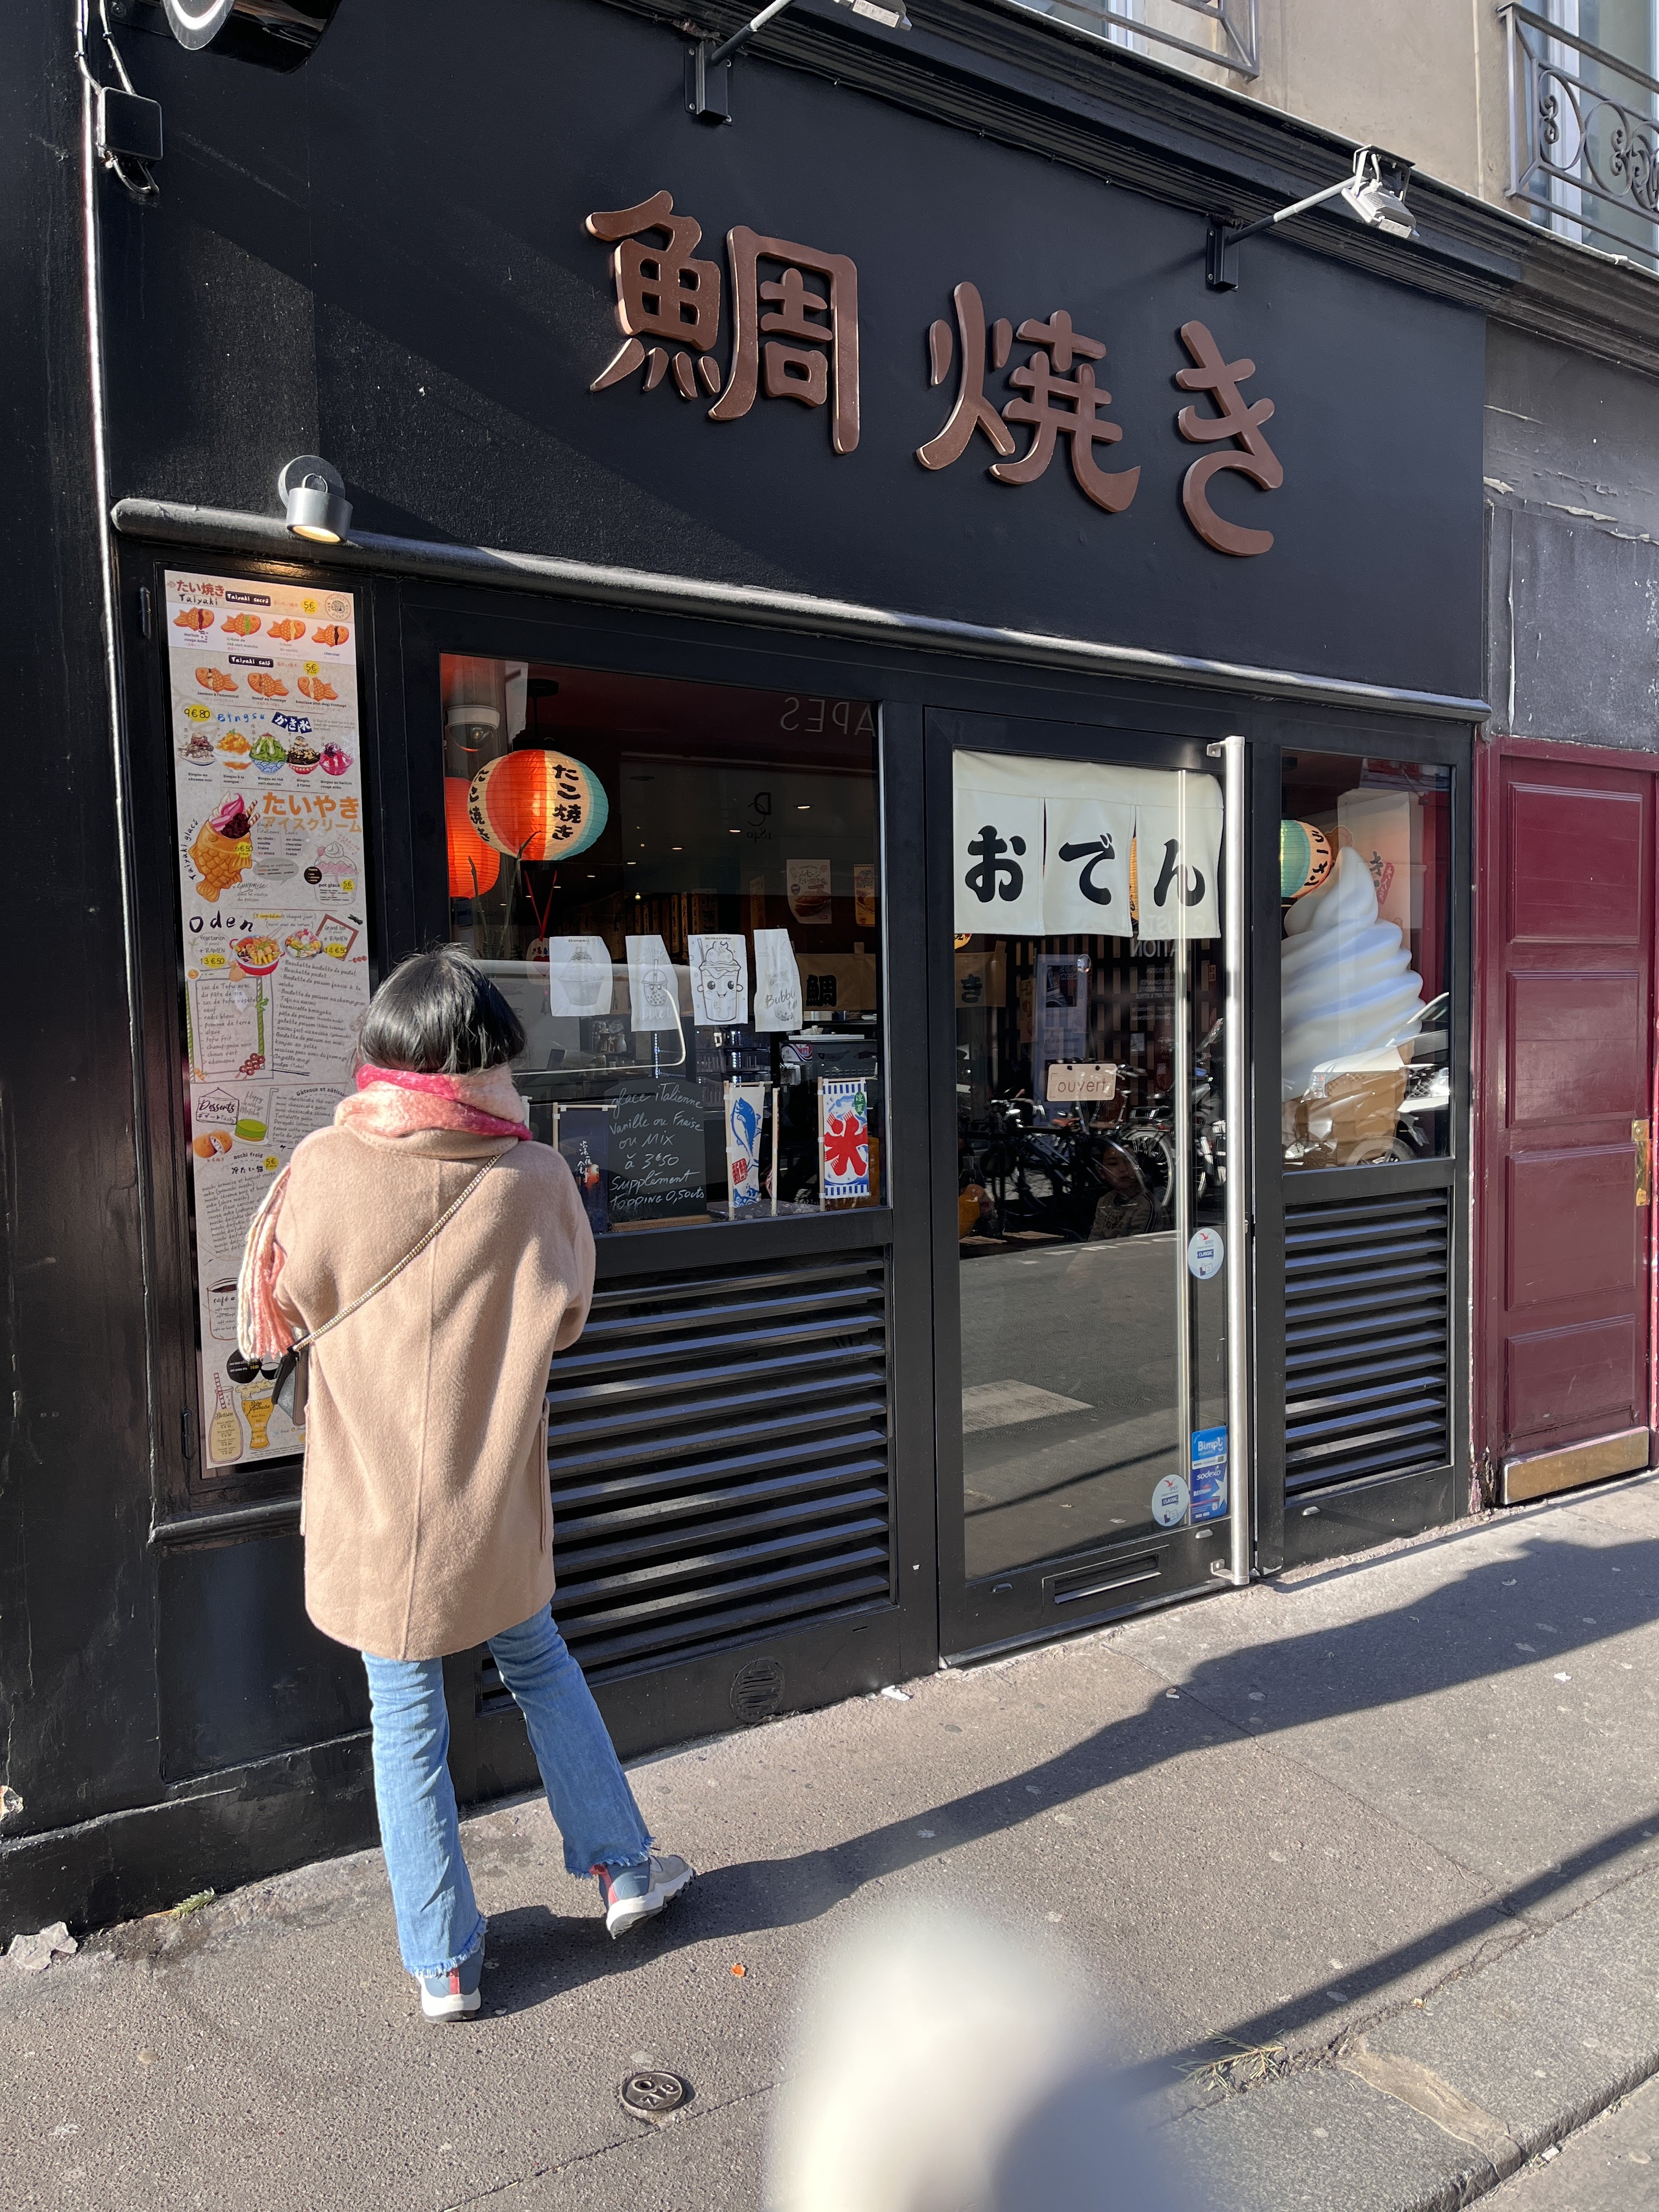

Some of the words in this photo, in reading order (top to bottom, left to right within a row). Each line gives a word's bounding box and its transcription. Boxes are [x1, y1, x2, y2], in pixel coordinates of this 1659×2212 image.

[585, 190, 1284, 556] 鯛焼き
[176, 580, 224, 597] たい焼き
[179, 594, 218, 606] Taiyaki
[227, 593, 250, 602] Taiyaki
[303, 601, 315, 610] 5€
[231, 656, 255, 664] Taiyaki
[306, 663, 317, 672] 5€
[184, 708, 211, 719] 9€80
[217, 711, 265, 723] Bingsu
[274, 715, 312, 731] かき氷
[263, 792, 359, 820] たいやき
[552, 764, 582, 840] たこ焼き
[262, 816, 363, 833] アイスクリーム
[965, 825, 1206, 907] おでん
[189, 910, 253, 933] Oden
[1057, 1077, 1108, 1094] ouvert
[199, 1099, 235, 1114] Desserts
[653, 1117, 668, 1126] ou
[673, 1110, 704, 1131] Fraise
[619, 1138, 637, 1149] ou
[1196, 1468, 1221, 1481] sodexo
